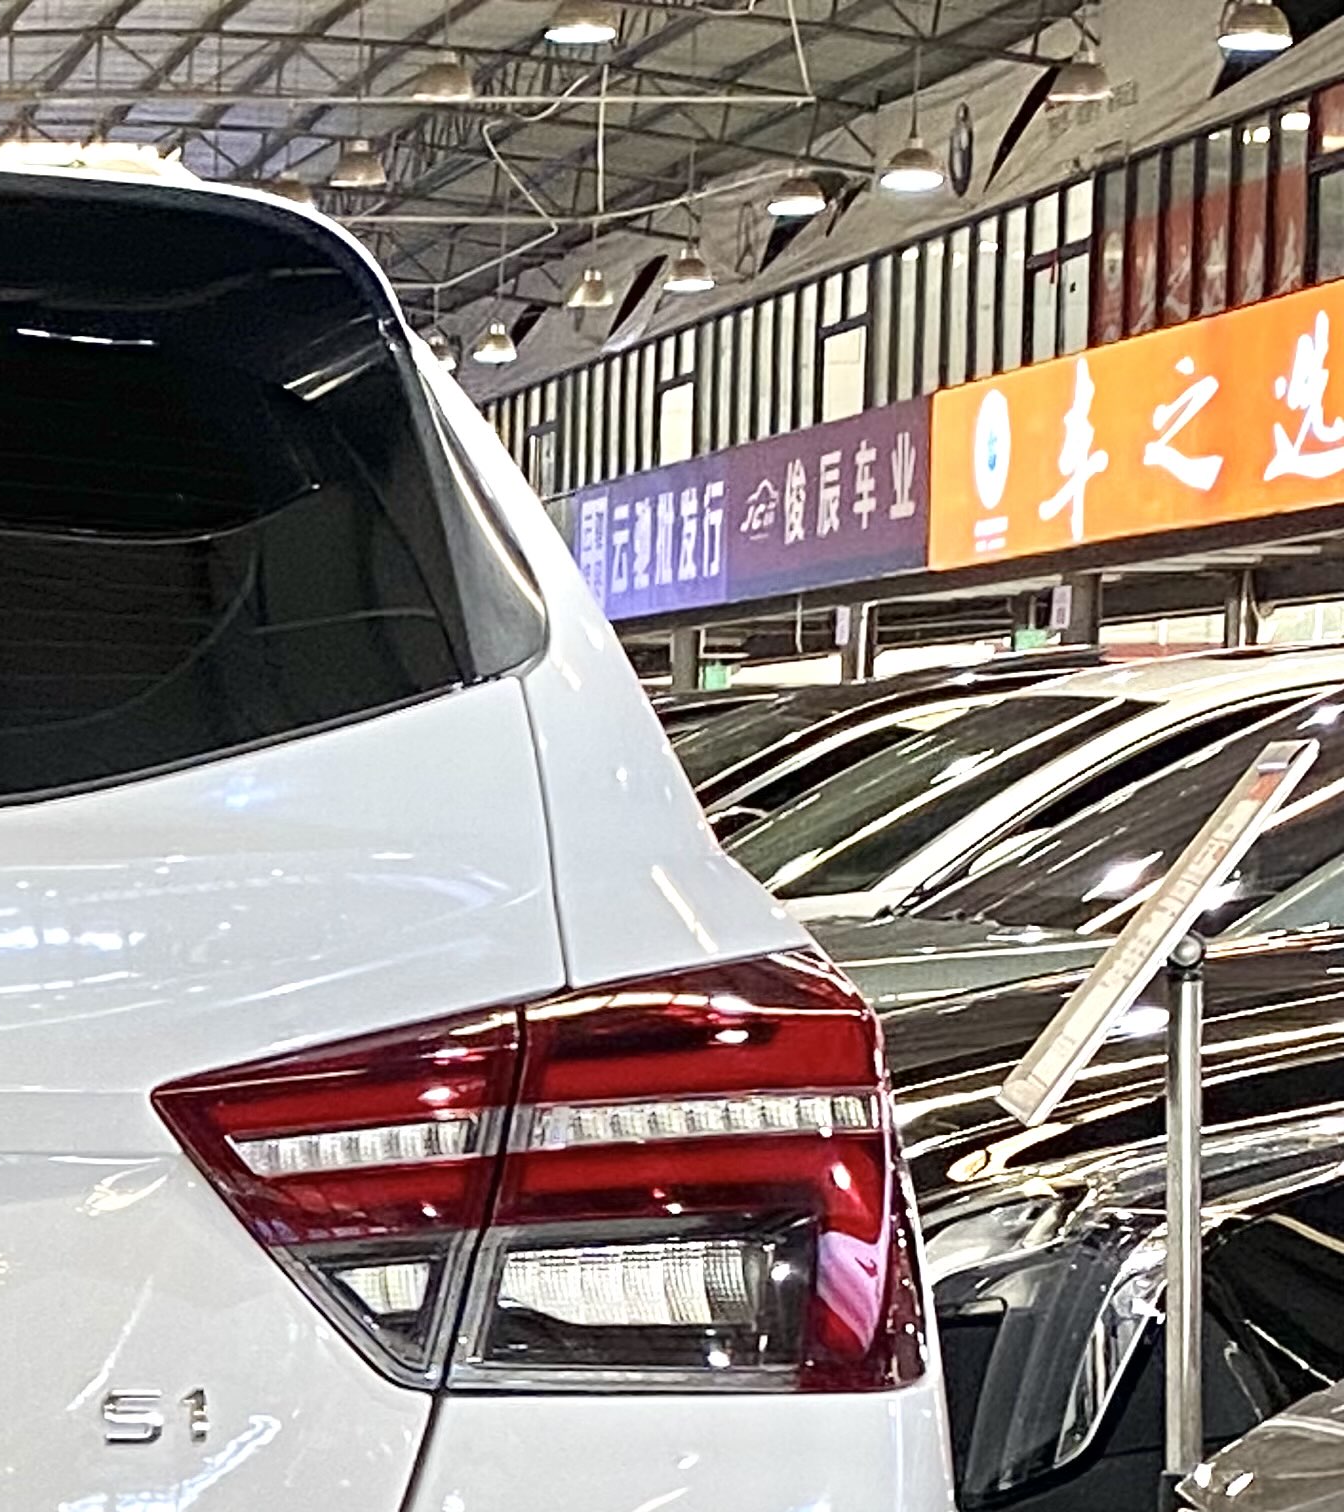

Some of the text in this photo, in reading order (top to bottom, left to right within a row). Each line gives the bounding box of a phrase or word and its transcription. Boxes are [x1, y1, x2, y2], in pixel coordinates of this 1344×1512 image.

[784, 432, 916, 545] 俊辰车业
[102, 1388, 211, 1445] S1
